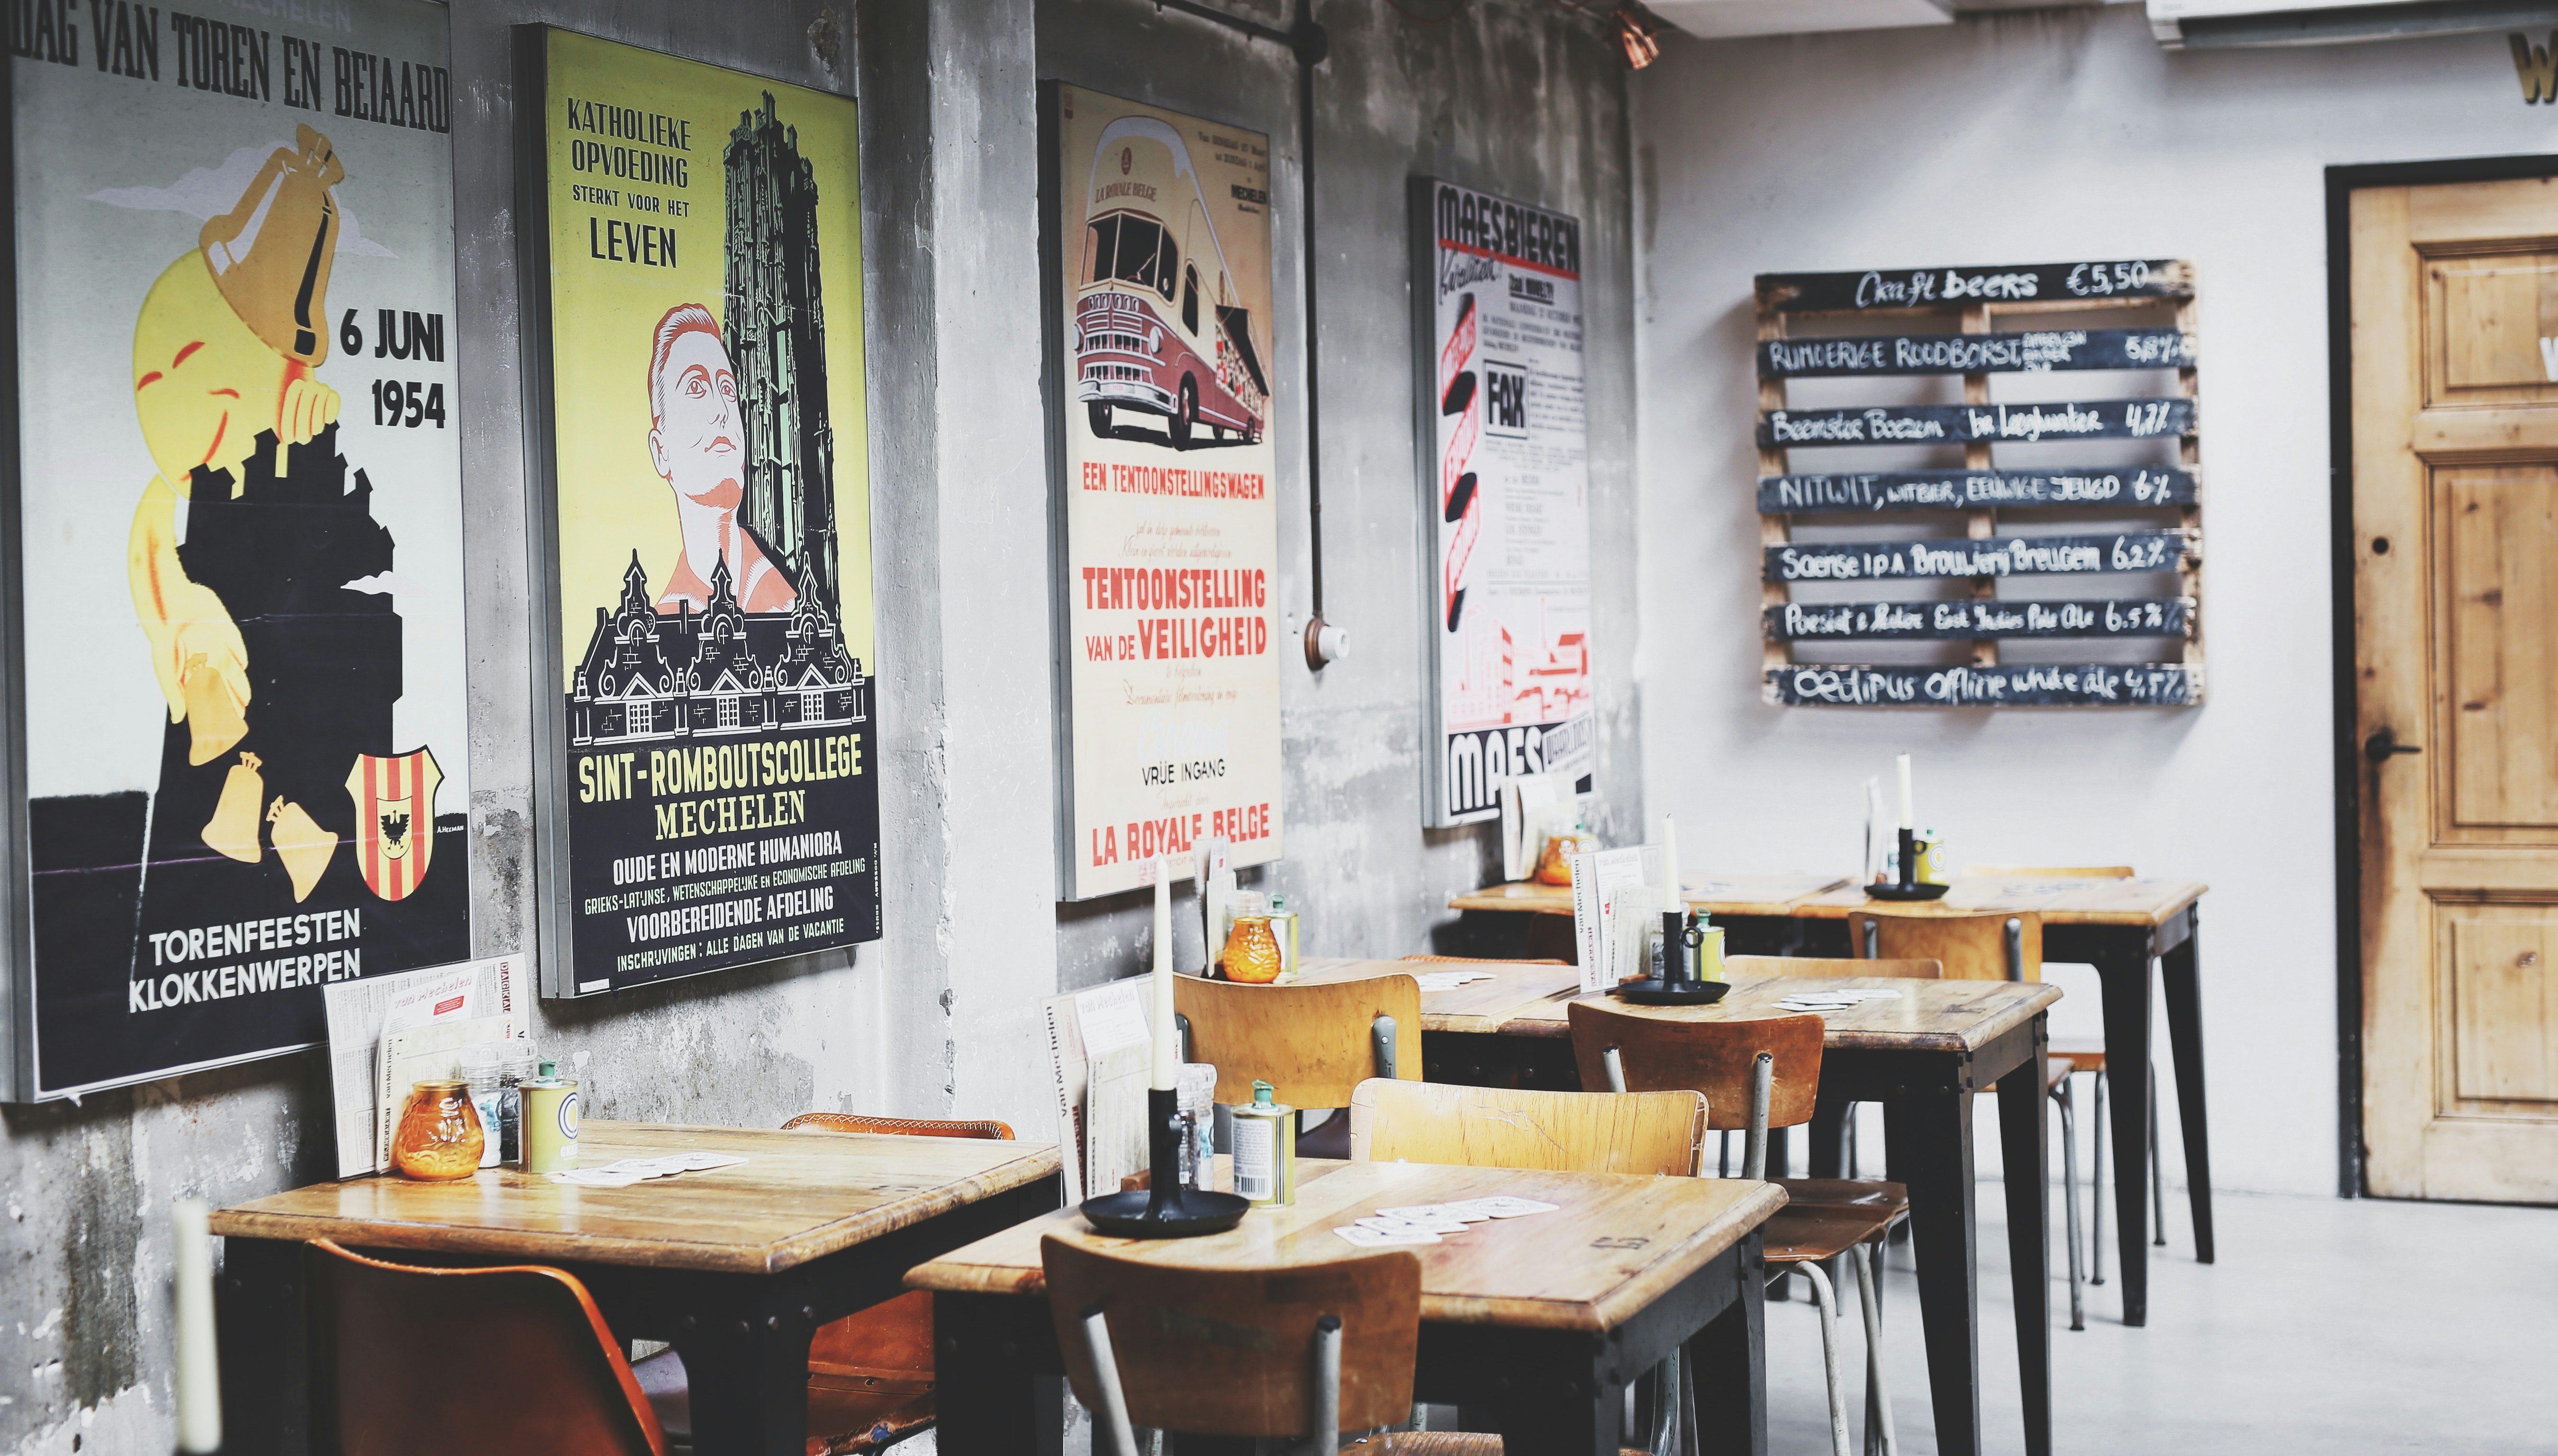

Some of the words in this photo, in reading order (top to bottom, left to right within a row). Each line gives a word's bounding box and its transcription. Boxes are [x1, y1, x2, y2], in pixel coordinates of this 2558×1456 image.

[10, 0, 79, 67] DAG
[90, 0, 159, 81] VAN
[171, 12, 270, 102] TOREN
[282, 35, 321, 112] EN
[333, 47, 451, 134] BEIAARD
[568, 97, 692, 151] KATHOLIEKE
[571, 139, 688, 189] OPVOEDING
[572, 184, 620, 207] STERKT
[628, 192, 660, 213] VOOR
[668, 199, 690, 217] HET
[589, 217, 677, 269] LEVEN
[1438, 185, 1580, 273] MAESBIEREN
[1855, 271, 1938, 309] Craft
[1940, 270, 2039, 298] beers
[2066, 262, 2150, 296] €5,50
[340, 308, 363, 356] 6
[374, 308, 444, 362] JUNI
[1770, 340, 1887, 371] RUMOERIGE
[371, 379, 445, 429] 1954
[1487, 371, 1525, 429] FAX
[1083, 462, 1107, 491] EEN
[1112, 464, 1265, 499] TENTOONSTELLINGSWAGEN
[1083, 567, 1266, 610] TENTOONSTELLING
[1085, 635, 1112, 661] VAN
[1119, 635, 1135, 660] DE
[1138, 616, 1267, 659] VEILIGHEID
[578, 733, 862, 804] SINT-ROMBOUTSCOLLEGE
[1142, 761, 1175, 786] VRIJE
[1181, 759, 1225, 782] INGANG
[655, 789, 806, 841] MECHELEN
[1093, 826, 1118, 867] LA
[1127, 813, 1202, 861] ROYALE
[1213, 803, 1269, 843] BELGE
[613, 854, 656, 886] OUDE
[660, 851, 680, 878] EN
[685, 841, 756, 876] MODERNE
[759, 830, 843, 865] HUMANIORA
[672, 873, 758, 902] WETENSCHAPPELIJKE
[773, 864, 828, 887] ECONOMISCHE
[831, 858, 866, 879] AFDELING
[1573, 859, 1583, 912] Mechelen
[149, 908, 361, 966] TORENFEESTEN
[626, 897, 763, 943] VOORBEREIDENDE
[767, 885, 834, 921] AFDELING
[706, 938, 729, 957] ALLE
[733, 931, 763, 952] DAGEN
[767, 929, 785, 945] VAN
[789, 925, 800, 942] DE
[803, 917, 845, 938] VACANTIE
[129, 948, 361, 1013] KLOKKENWERPEN
[394, 993, 416, 1009] van
[417, 975, 472, 1002] Mechelen
[385, 1039, 393, 1081] Mechelen
[1045, 1005, 1063, 1085] Mechelen
[1058, 1088, 1067, 1118] van
